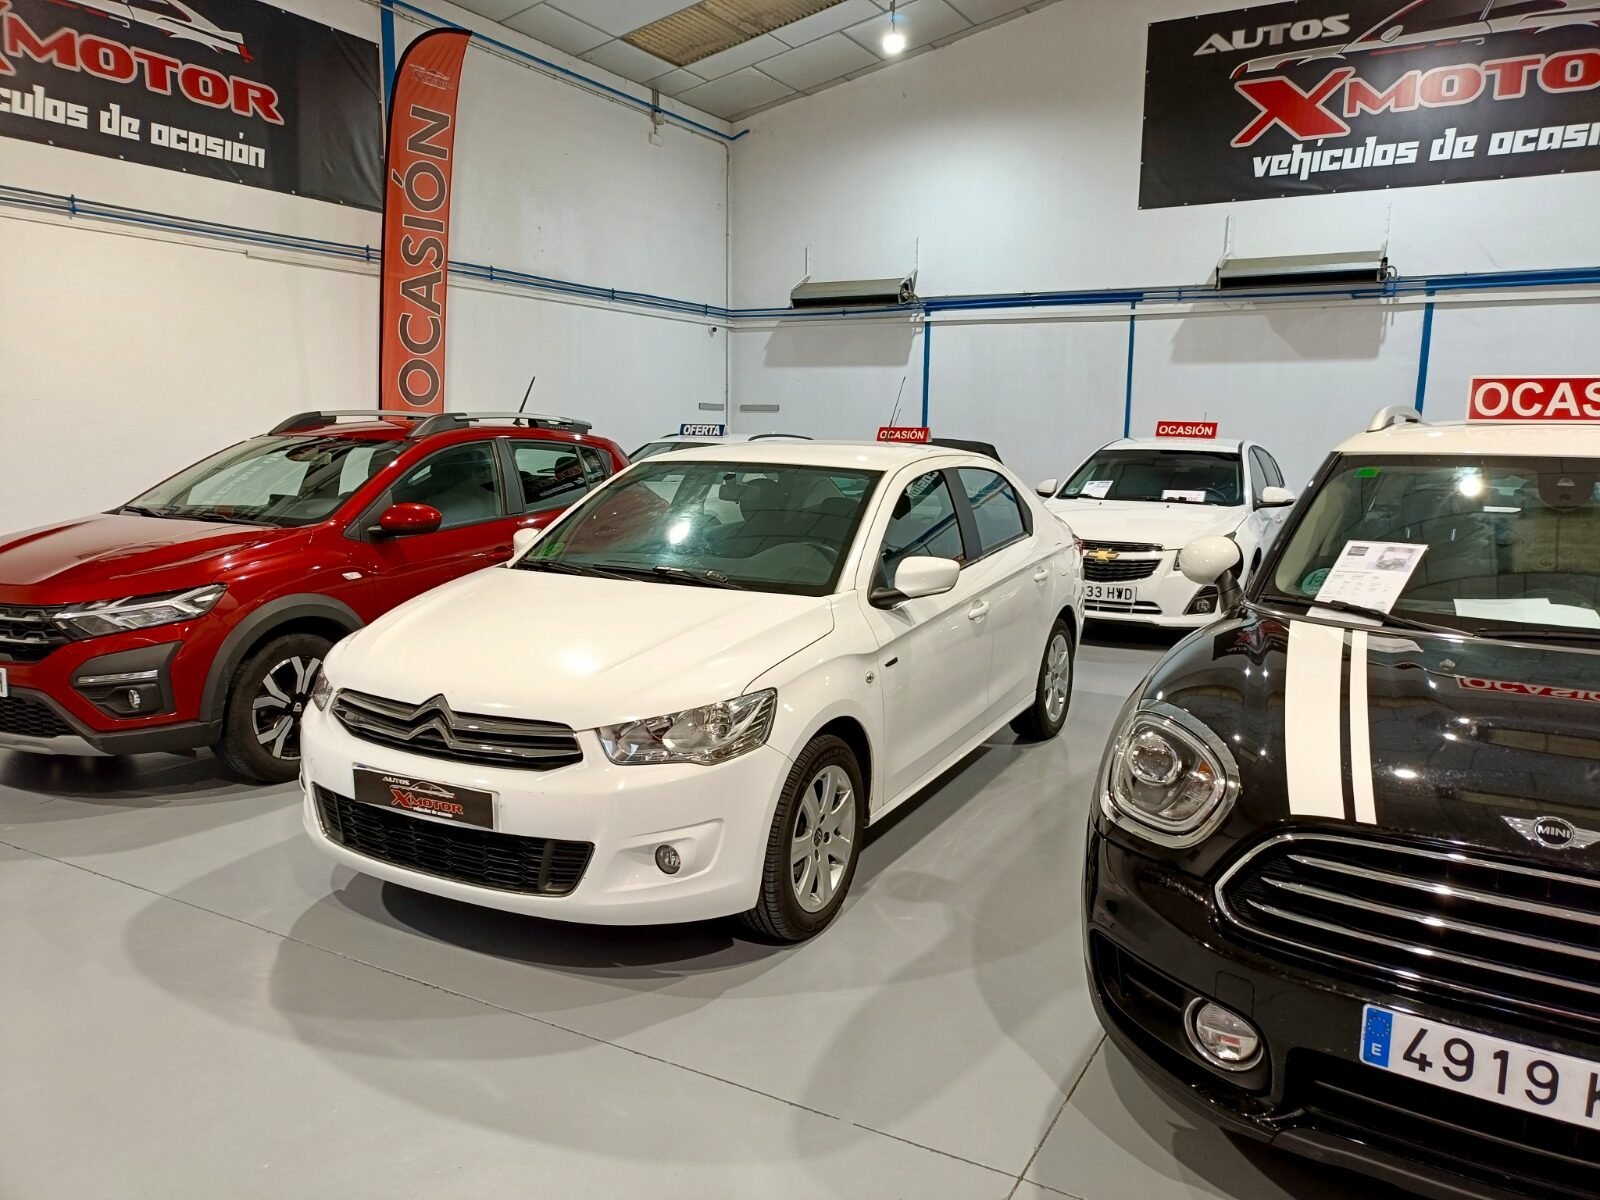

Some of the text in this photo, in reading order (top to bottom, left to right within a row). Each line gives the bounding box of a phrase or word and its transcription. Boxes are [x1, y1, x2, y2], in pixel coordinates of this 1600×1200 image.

[1193, 13, 1350, 56] AUTOS
[0, 2, 284, 125] MOTOR
[100, 102, 140, 141] de
[151, 122, 265, 169] ocasión
[1253, 122, 1600, 181] vehículos de ocasi
[391, 104, 451, 407] OCASIÓN
[683, 424, 721, 436] OFERTA
[880, 428, 925, 440] OCASIÓN
[1158, 423, 1213, 436] OCASIÓN
[1086, 585, 1102, 598] 33
[382, 776, 411, 786] AUTOS
[390, 789, 464, 815] XMOTOR
[1537, 824, 1571, 839] MINI
[1371, 1042, 1382, 1057] E
[1402, 1028, 1560, 1106] 4919
